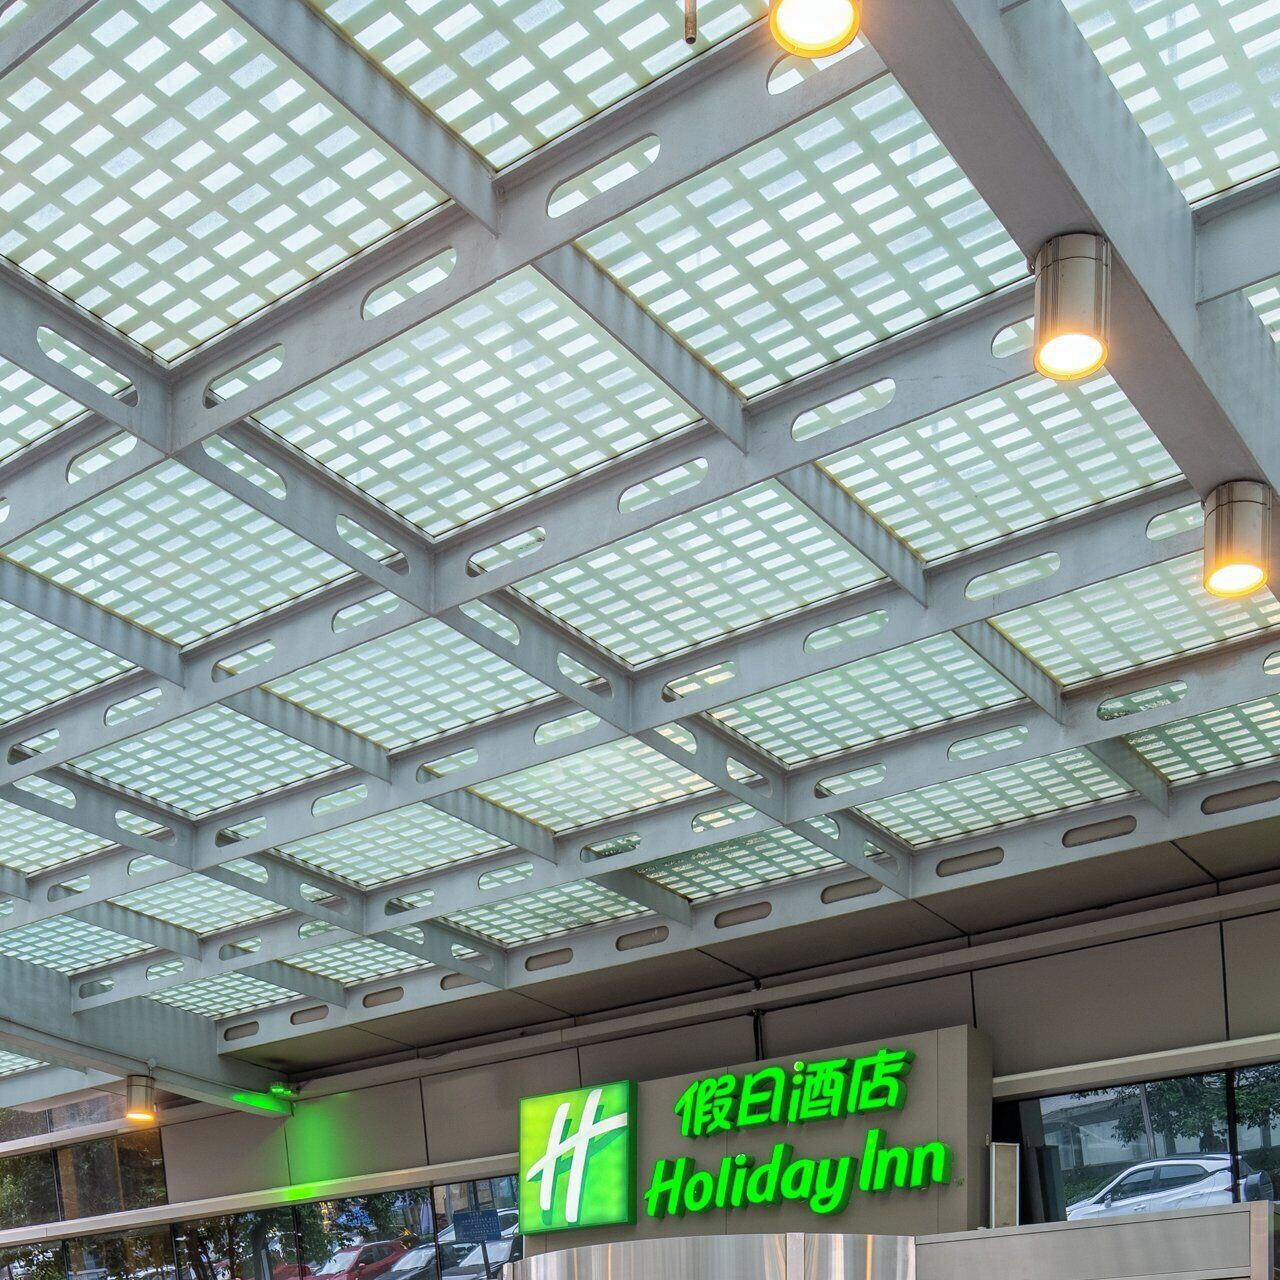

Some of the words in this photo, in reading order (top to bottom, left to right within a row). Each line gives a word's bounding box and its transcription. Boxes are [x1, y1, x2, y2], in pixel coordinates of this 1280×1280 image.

[674, 1048, 914, 1137] 假日酒店
[644, 1144, 855, 1215] Holiday
[859, 1129, 951, 1191] Inn
